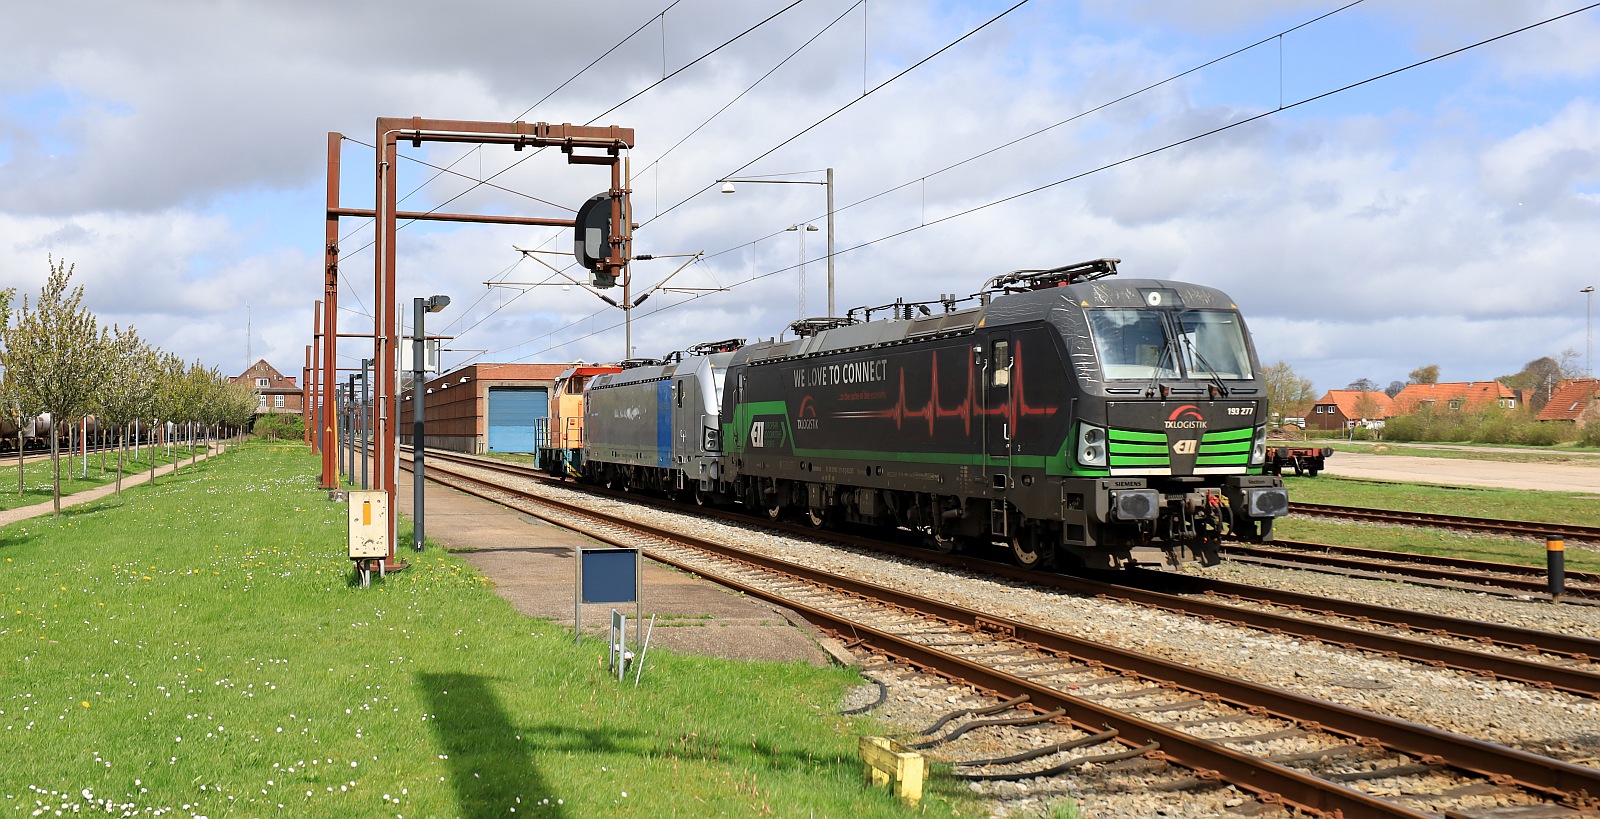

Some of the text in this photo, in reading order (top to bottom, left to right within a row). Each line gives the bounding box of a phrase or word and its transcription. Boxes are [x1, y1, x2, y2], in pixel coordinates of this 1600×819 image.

[793, 359, 888, 388] WE LOVE TO CONNECT
[1227, 407, 1254, 415] 193 277
